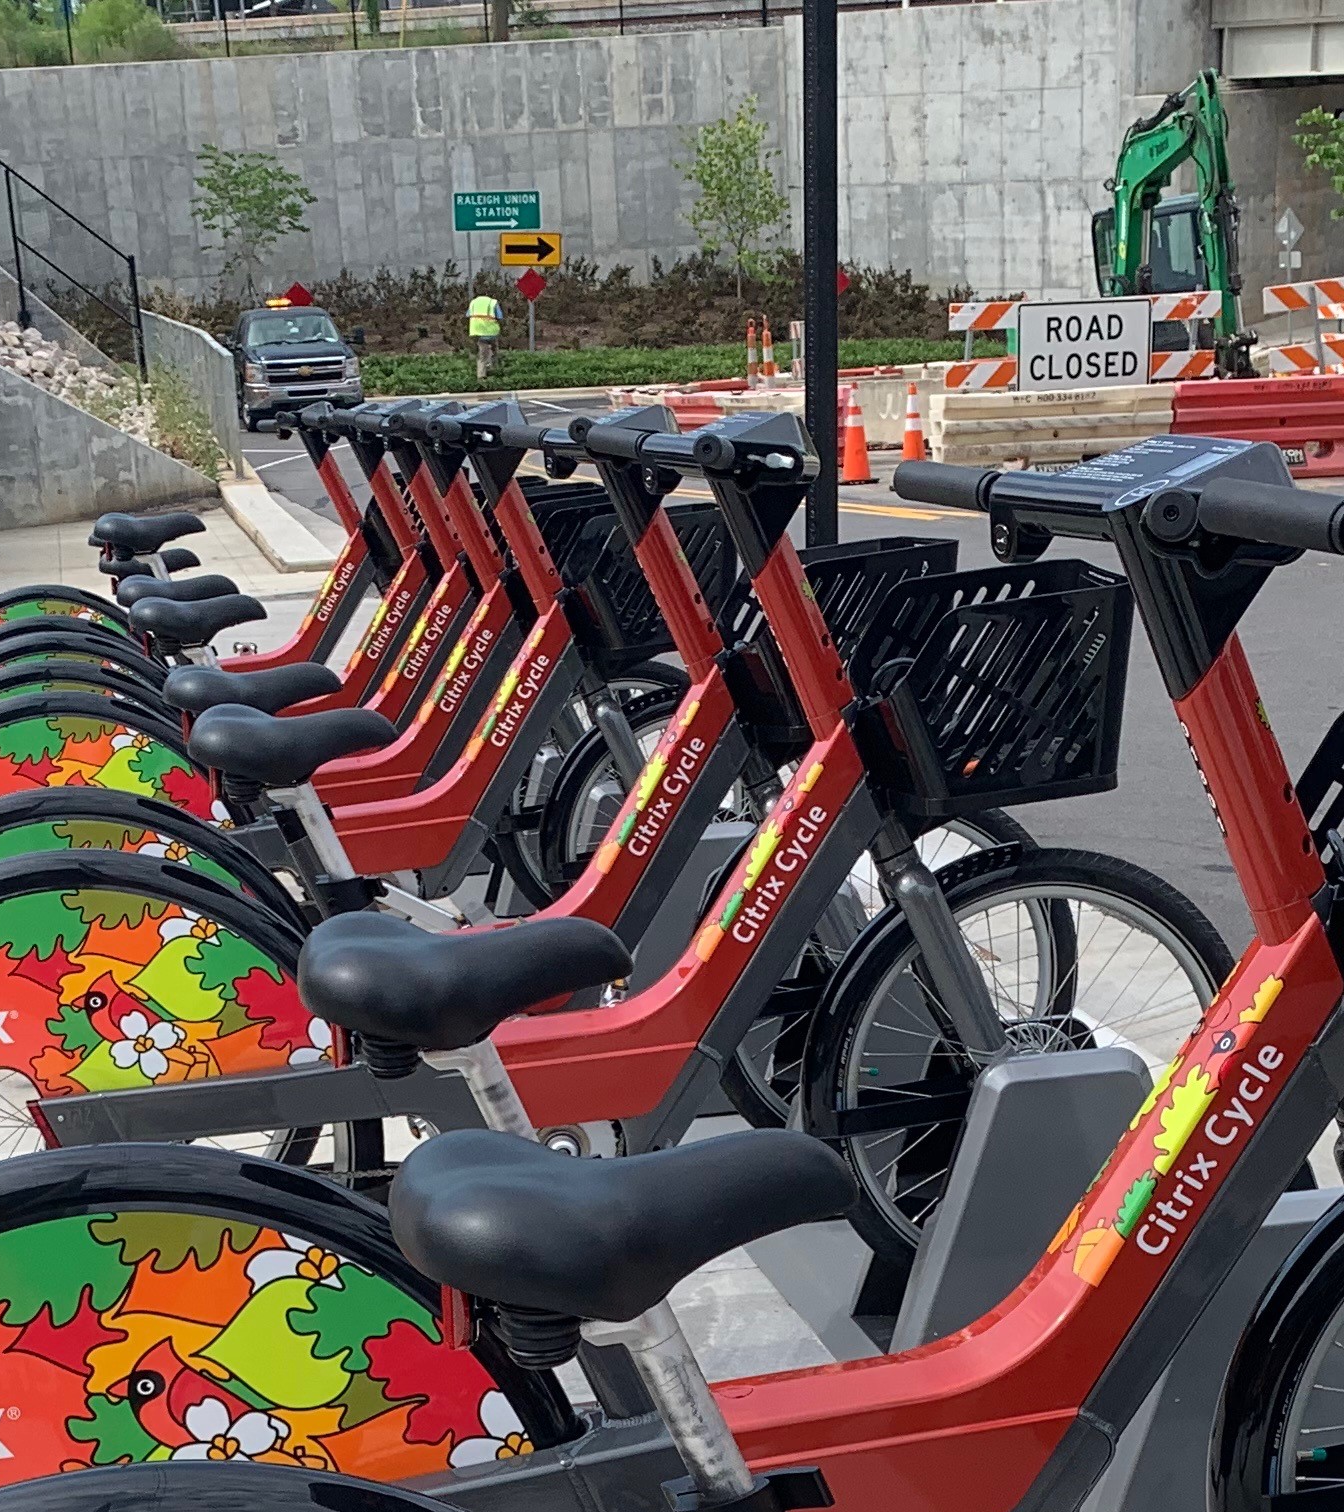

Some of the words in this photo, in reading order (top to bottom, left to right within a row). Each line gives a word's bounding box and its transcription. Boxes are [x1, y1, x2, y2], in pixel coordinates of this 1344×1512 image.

[456, 195, 500, 205] RALEIGH
[504, 194, 536, 204] UNION
[475, 207, 519, 217] STATION
[1046, 314, 1123, 343] ROAD
[1029, 351, 1138, 381] CLOSED
[317, 593, 339, 622] Citrix
[332, 562, 355, 592] Cycle
[366, 625, 392, 660] Citrix
[385, 590, 411, 624] Cycle
[403, 641, 432, 680] Citrix
[424, 604, 452, 640] Cycle
[439, 671, 471, 713] Citrix
[463, 629, 493, 670] Cycle
[490, 701, 525, 747] Citrix
[516, 654, 550, 699] Cycle
[628, 797, 672, 858] Citrix
[662, 736, 706, 795] Cycle
[732, 875, 785, 943] Citrix
[774, 805, 827, 873] Cycle
[1136, 1152, 1218, 1256] Citrix
[1204, 1044, 1284, 1146] Cycle
